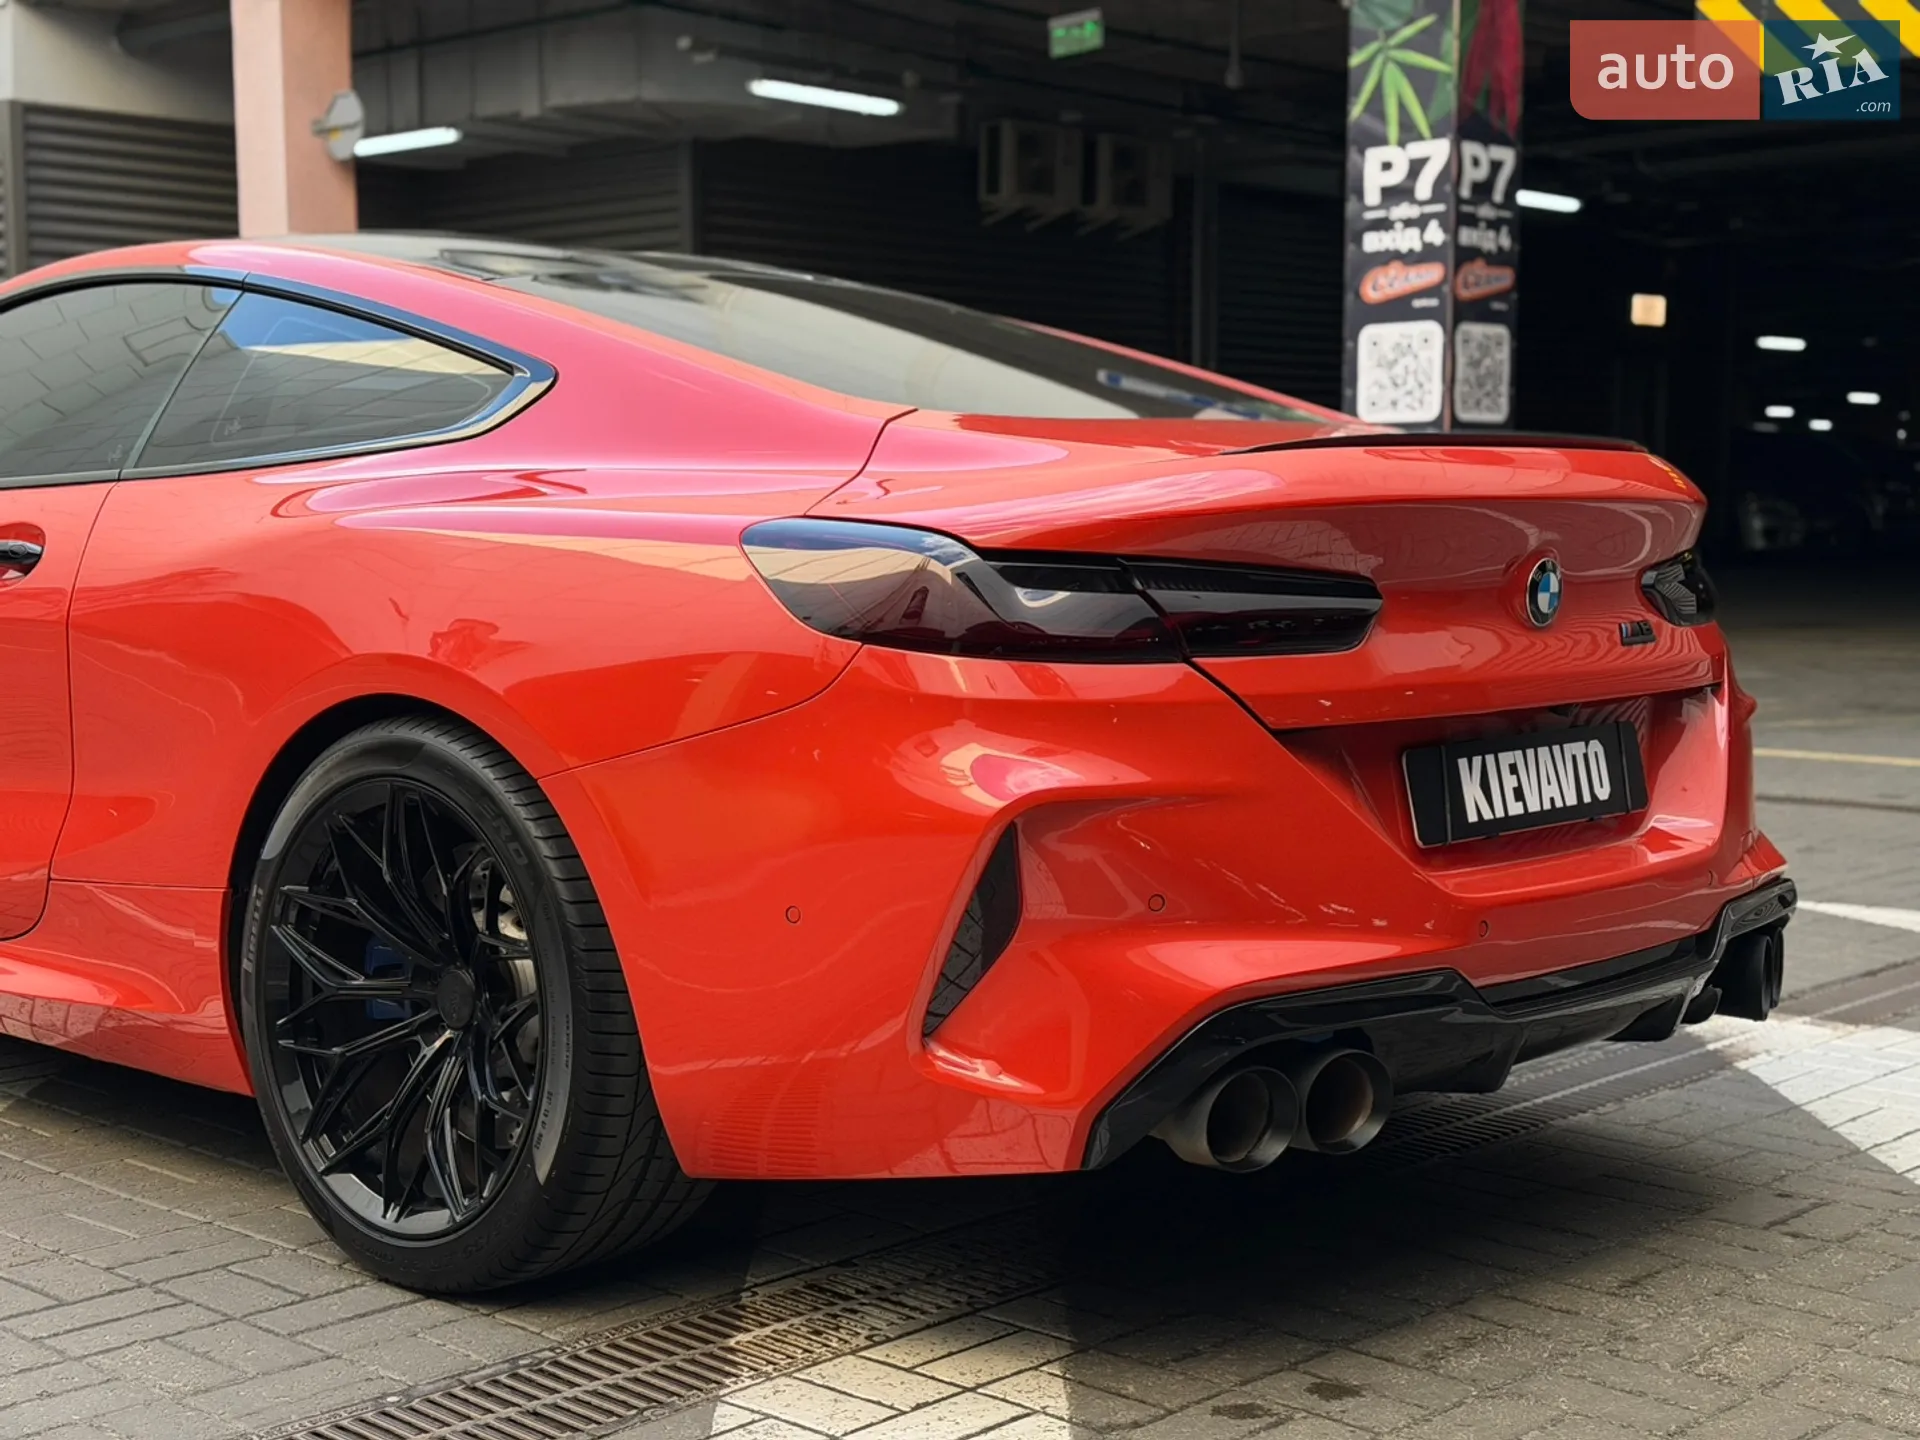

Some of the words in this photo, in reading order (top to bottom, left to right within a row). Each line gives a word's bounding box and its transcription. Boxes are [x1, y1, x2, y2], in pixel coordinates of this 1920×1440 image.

[1363, 138, 1450, 207] P7
[1459, 140, 1516, 203] P7
[1457, 739, 1612, 824] KIEVAVTO
